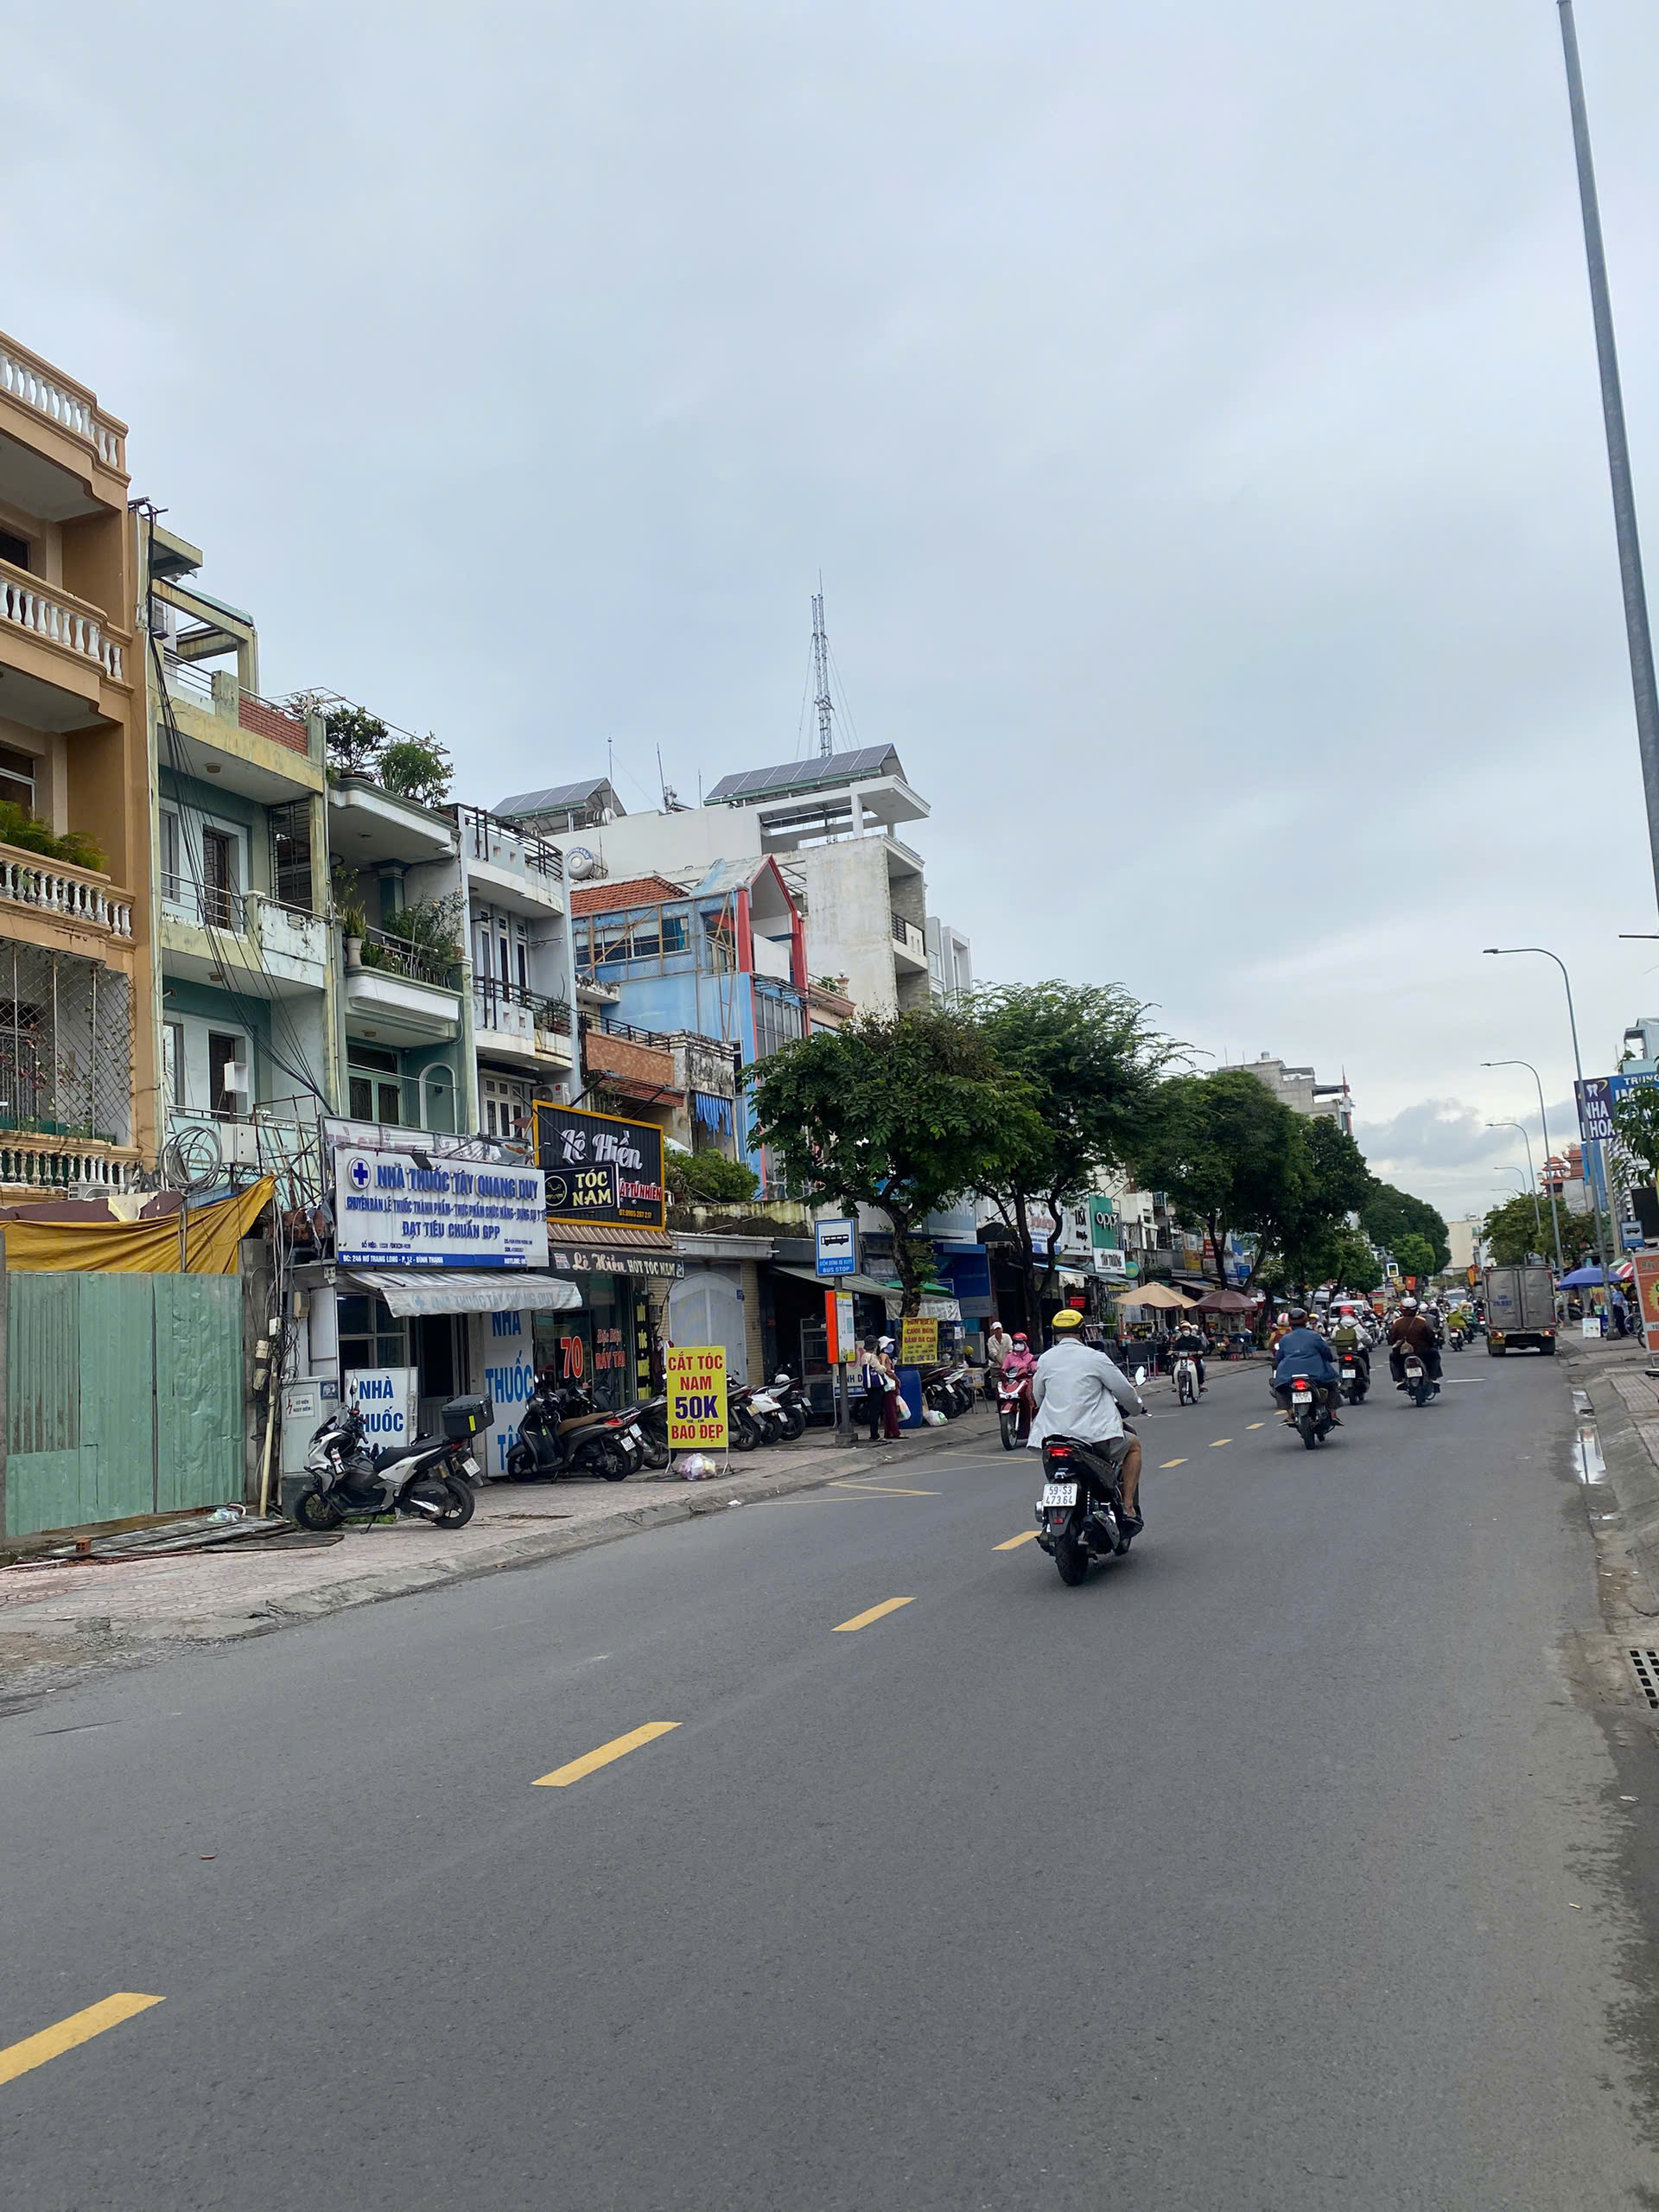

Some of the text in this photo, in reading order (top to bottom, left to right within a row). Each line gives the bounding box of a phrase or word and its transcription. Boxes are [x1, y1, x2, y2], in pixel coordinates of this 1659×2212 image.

[560, 1129, 644, 1170] Lê Hiền
[375, 1162, 538, 1200] NHÀ THUỐC TÂY QUANG DUY
[575, 1168, 608, 1189] TÓC
[572, 1188, 612, 1207] NAM
[402, 1219, 500, 1240] ĐẠT TIÊU CHUẨN GPP
[572, 1251, 592, 1271] Lê
[592, 1253, 627, 1273] Hiền
[644, 1258, 659, 1274] TÓC
[659, 1262, 676, 1276] NAM
[561, 1336, 583, 1378] 70
[668, 1351, 693, 1371] CẮT
[697, 1352, 723, 1370] TÓC
[359, 1376, 394, 1399] NHÀ
[485, 1350, 533, 1403] THUỐC
[680, 1376, 712, 1391] NAM
[360, 1406, 404, 1432] HUỐC
[675, 1395, 718, 1420] 50K
[671, 1424, 724, 1442] BAO ĐẸP
